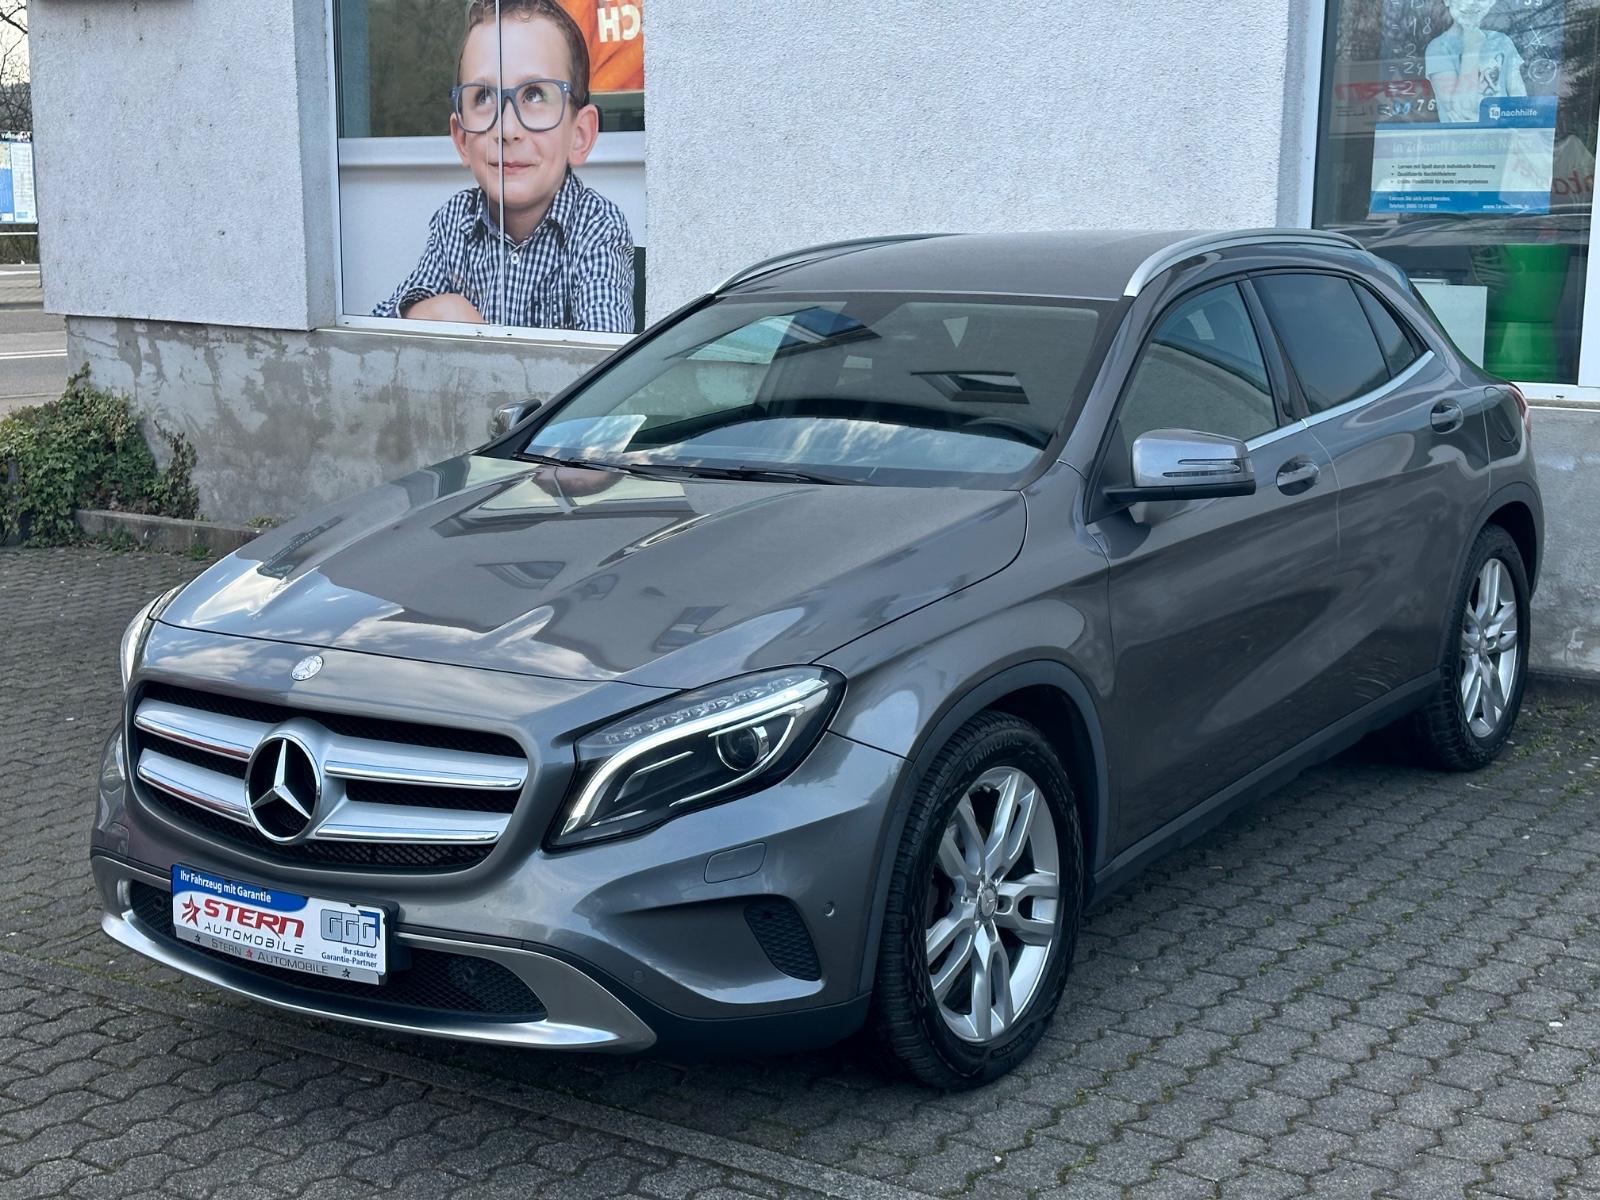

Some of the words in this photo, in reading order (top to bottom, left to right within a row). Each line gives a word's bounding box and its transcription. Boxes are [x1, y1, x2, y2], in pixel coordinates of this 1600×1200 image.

[1500, 107, 1538, 117] nachhilfe
[180, 869, 190, 882] Ihr
[190, 873, 222, 894] Fahrzeug
[223, 883, 236, 895] mit
[237, 885, 272, 903] Garantie
[204, 898, 305, 940] STERN
[204, 922, 305, 955] AUTOMOBILE
[257, 952, 329, 975] AUTOMOBILE
[321, 952, 377, 967] Garantie-Partner
[342, 946, 352, 955] Ihr
[353, 949, 377, 959] starker
